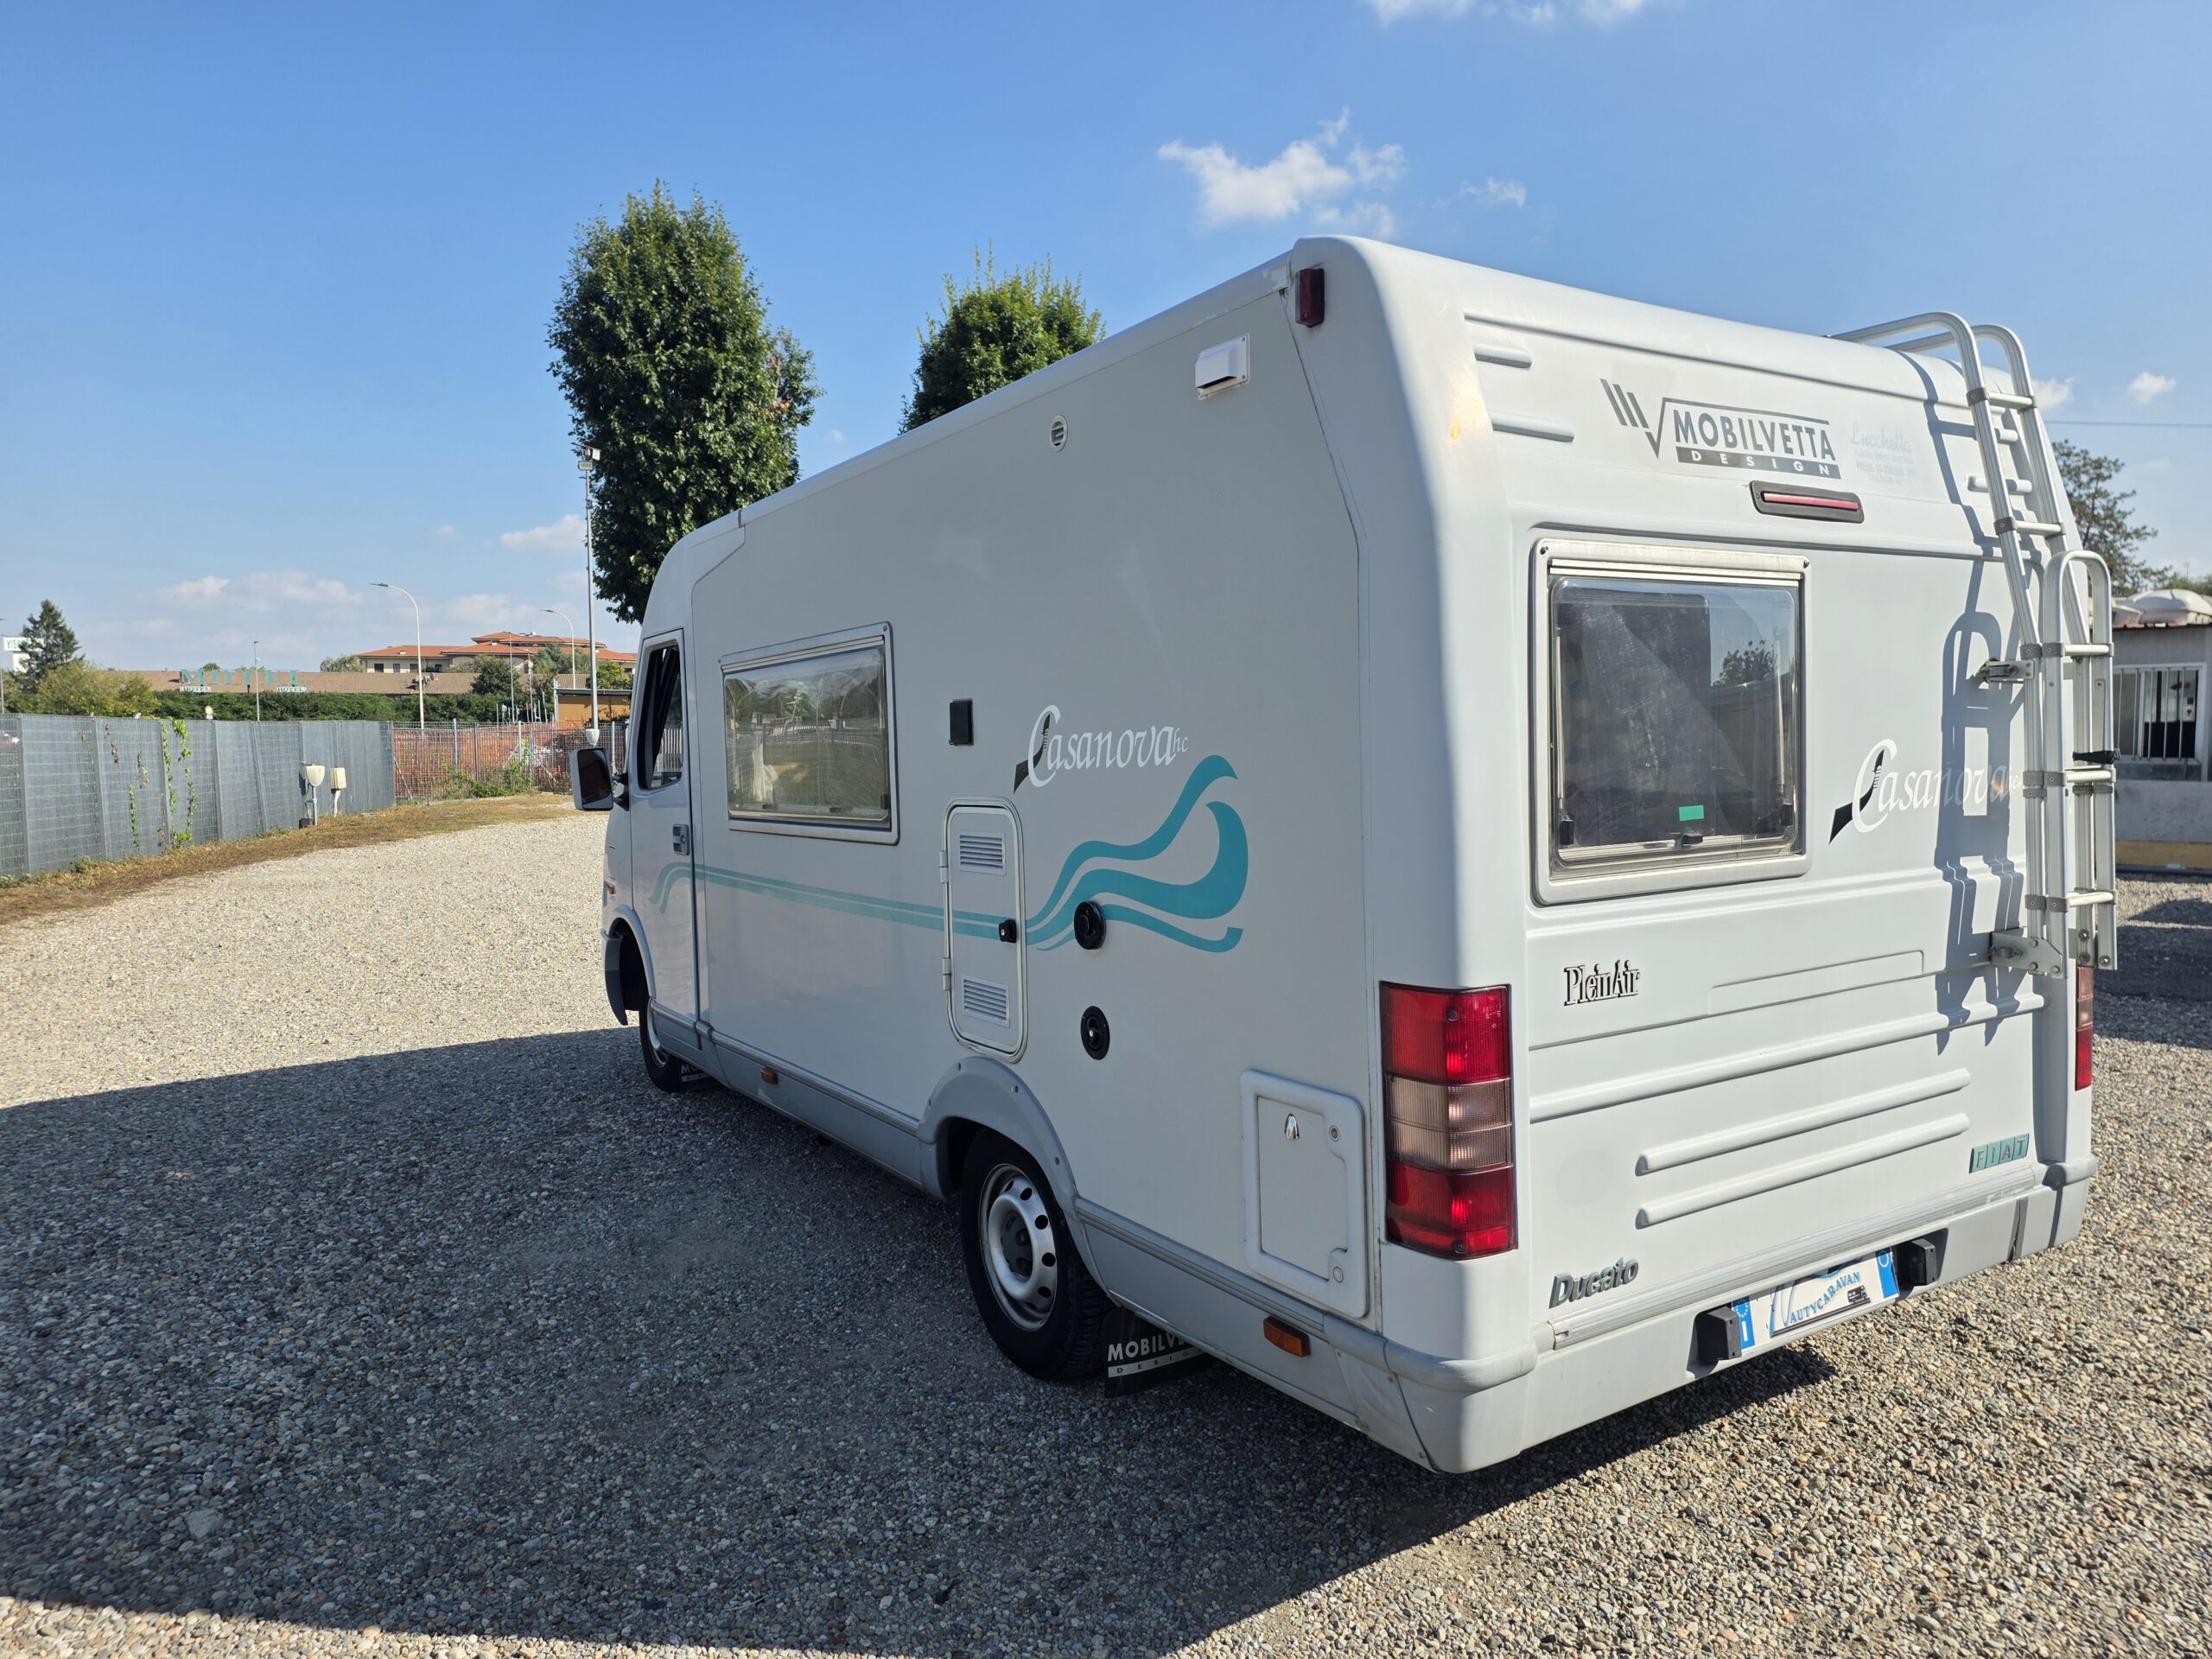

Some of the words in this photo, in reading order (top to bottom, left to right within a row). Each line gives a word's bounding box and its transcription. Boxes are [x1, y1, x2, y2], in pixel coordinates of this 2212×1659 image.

[1673, 410, 1836, 461] MOBILVETTA
[1691, 450, 1830, 476] DESIGN
[180, 668, 307, 685] MOTEL
[1026, 704, 1177, 788] Casanova
[1851, 739, 2008, 834] Casanova
[1563, 959, 1641, 1007] PleinAir
[1975, 1138, 2027, 1168] FIAT
[1548, 1256, 1639, 1309] Ducato
